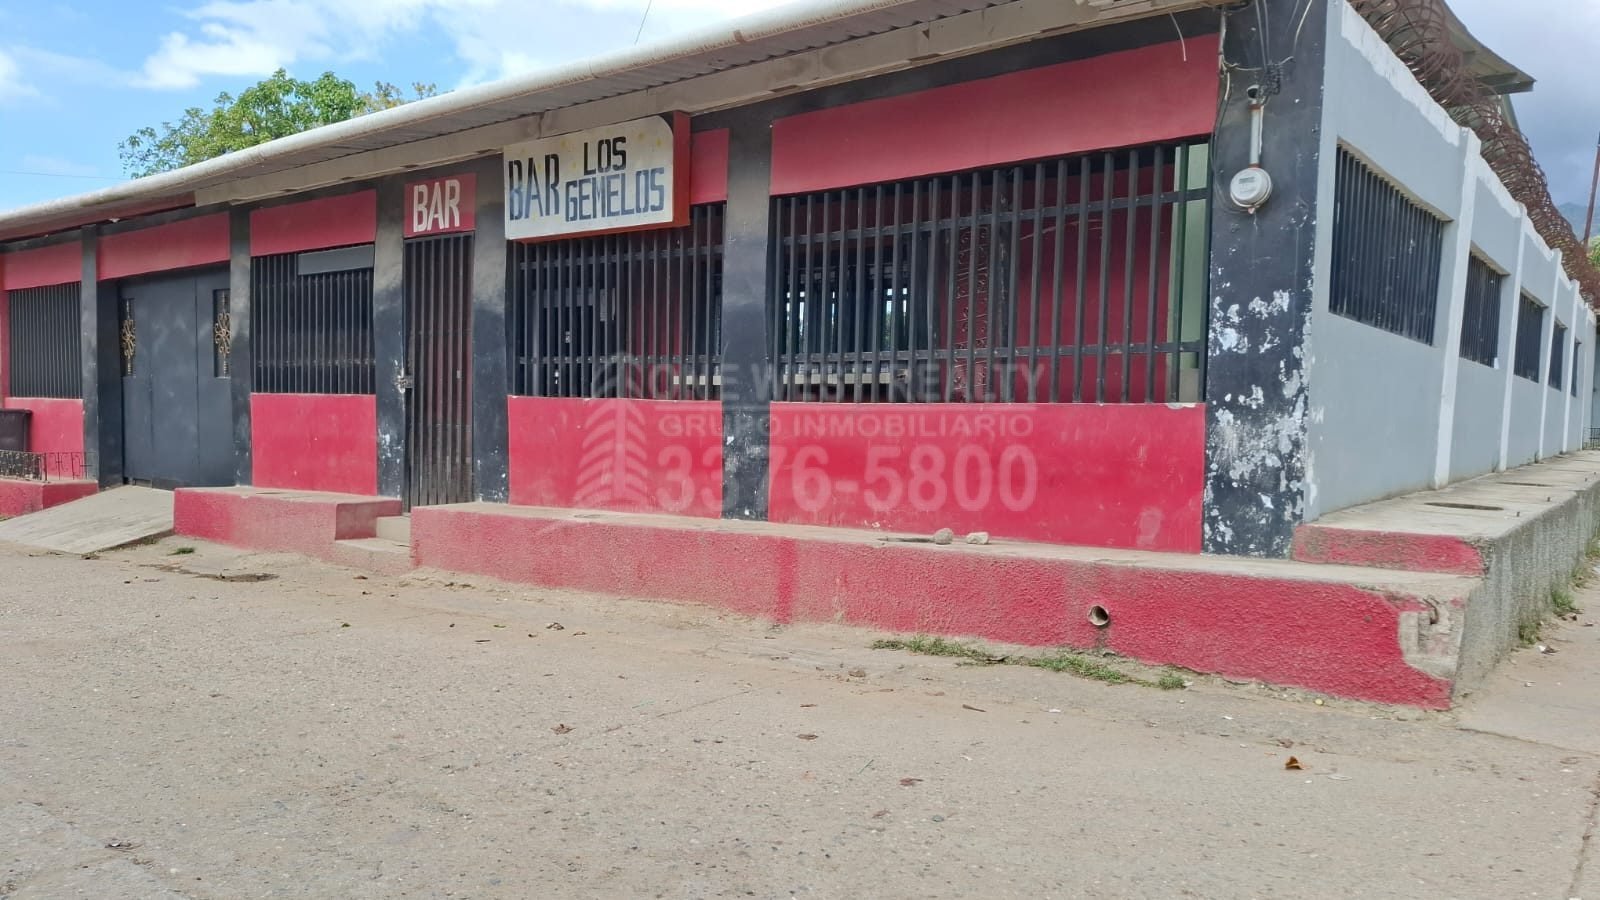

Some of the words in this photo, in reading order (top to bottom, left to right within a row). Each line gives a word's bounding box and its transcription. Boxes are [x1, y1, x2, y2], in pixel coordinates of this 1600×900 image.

[583, 136, 627, 176] LOS
[413, 179, 460, 233] BAR
[508, 153, 560, 221] BAR
[565, 167, 665, 222] GEMELOS
